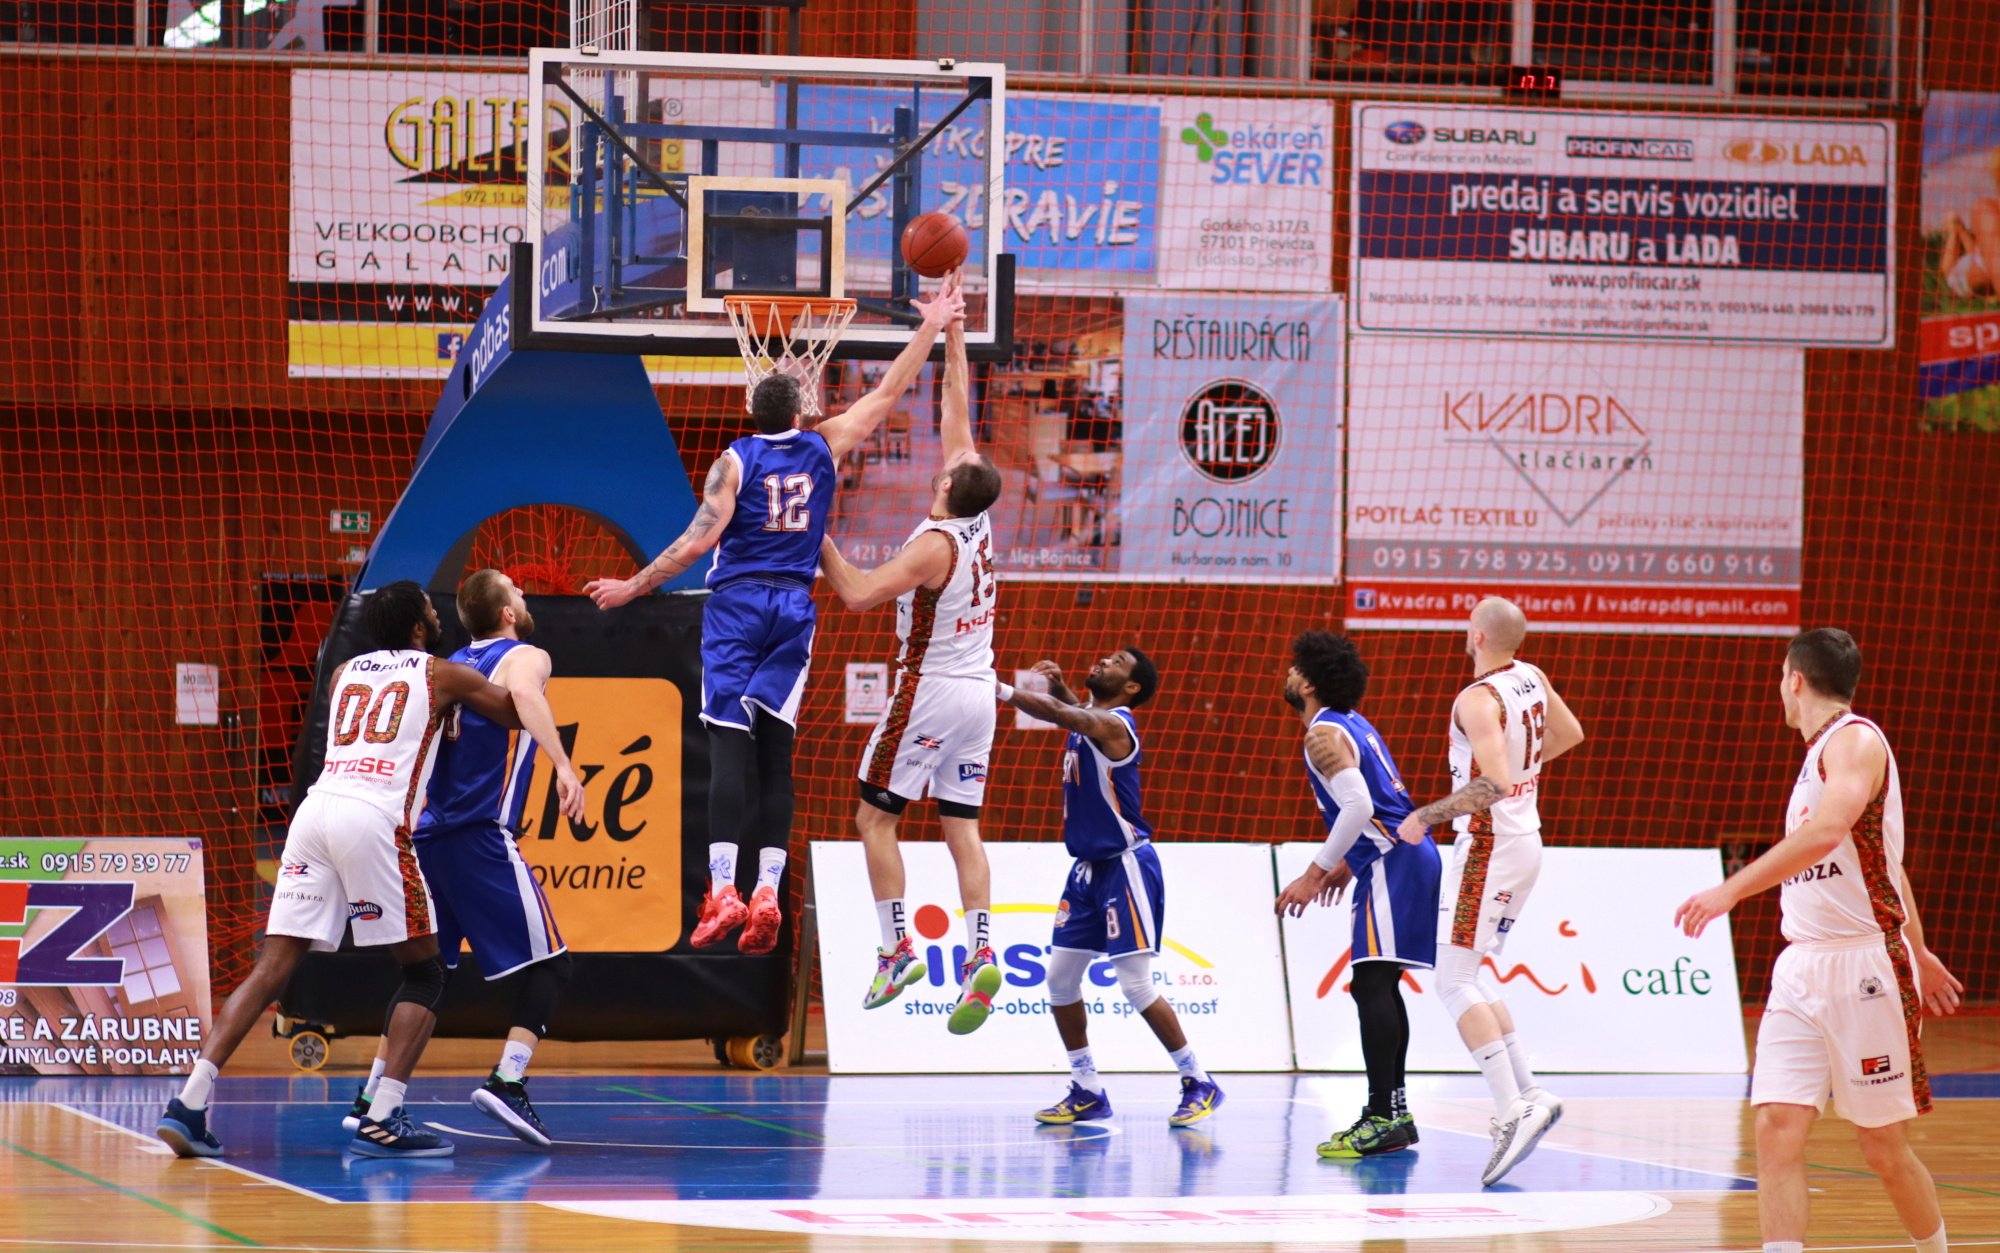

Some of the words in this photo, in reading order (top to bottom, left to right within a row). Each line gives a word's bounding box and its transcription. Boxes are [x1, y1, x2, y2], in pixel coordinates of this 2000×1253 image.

[1232, 124, 1324, 151] ekáreň
[1434, 128, 1537, 146] SUBARU
[1004, 131, 1067, 171] PRE
[1385, 151, 1466, 165] Confidence
[1470, 152, 1481, 164] in
[1483, 152, 1533, 166] Motion
[1792, 143, 1868, 167] LADA
[1211, 151, 1324, 186] SEVER
[1450, 180, 1550, 220] predaj
[1557, 195, 1578, 214] a
[1586, 184, 1674, 217] servis
[1682, 187, 1799, 221] vozidiel
[315, 221, 548, 245] VEĽKOOBCHO
[1201, 218, 1263, 234] Gorkého
[1267, 219, 1310, 235] 317/3
[1200, 235, 1246, 250] 97101
[1250, 236, 1315, 252] Prievidza
[1509, 228, 1630, 260] SUBARU
[1637, 238, 1657, 261] a
[1665, 232, 1741, 265] LADA
[1549, 271, 1701, 294] www.profincar.sk
[1443, 391, 1647, 437] KVADRA
[1194, 399, 1268, 464] ALEJ
[1519, 450, 1653, 471] tlačiareň
[762, 473, 814, 532] 12
[1172, 497, 1289, 539] BOJNICE
[1356, 503, 1443, 525] POTLAČ
[1452, 507, 1539, 528] TEXTILU
[1009, 548, 1092, 567] Alej-Bojnice
[1277, 553, 1292, 567] 10
[1373, 547, 1442, 569] 0915
[1459, 549, 1507, 571] 798
[1517, 551, 1578, 575] 925,
[1588, 552, 1657, 574] 0917
[1666, 553, 1716, 575] 660
[1724, 554, 1774, 576] 916
[1379, 592, 1442, 610] Kvadra
[1452, 593, 1477, 611] PD
[1596, 594, 1789, 617] kvadrapd@gmail.com
[333, 680, 410, 747] 00
[41, 853, 95, 872] 0915
[100, 854, 128, 872] 79
[132, 854, 159, 873] 39
[164, 854, 191, 873] 77
[1153, 972, 1173, 986] PL
[1179, 973, 1218, 987] s.r.o.
[1622, 956, 1712, 996] cafe
[33, 1018, 53, 1041] A
[60, 1014, 202, 1042] ZÁRUBNE
[103, 1047, 200, 1067] PODLAHY
[1870, 1072, 1905, 1085] FRANKO
